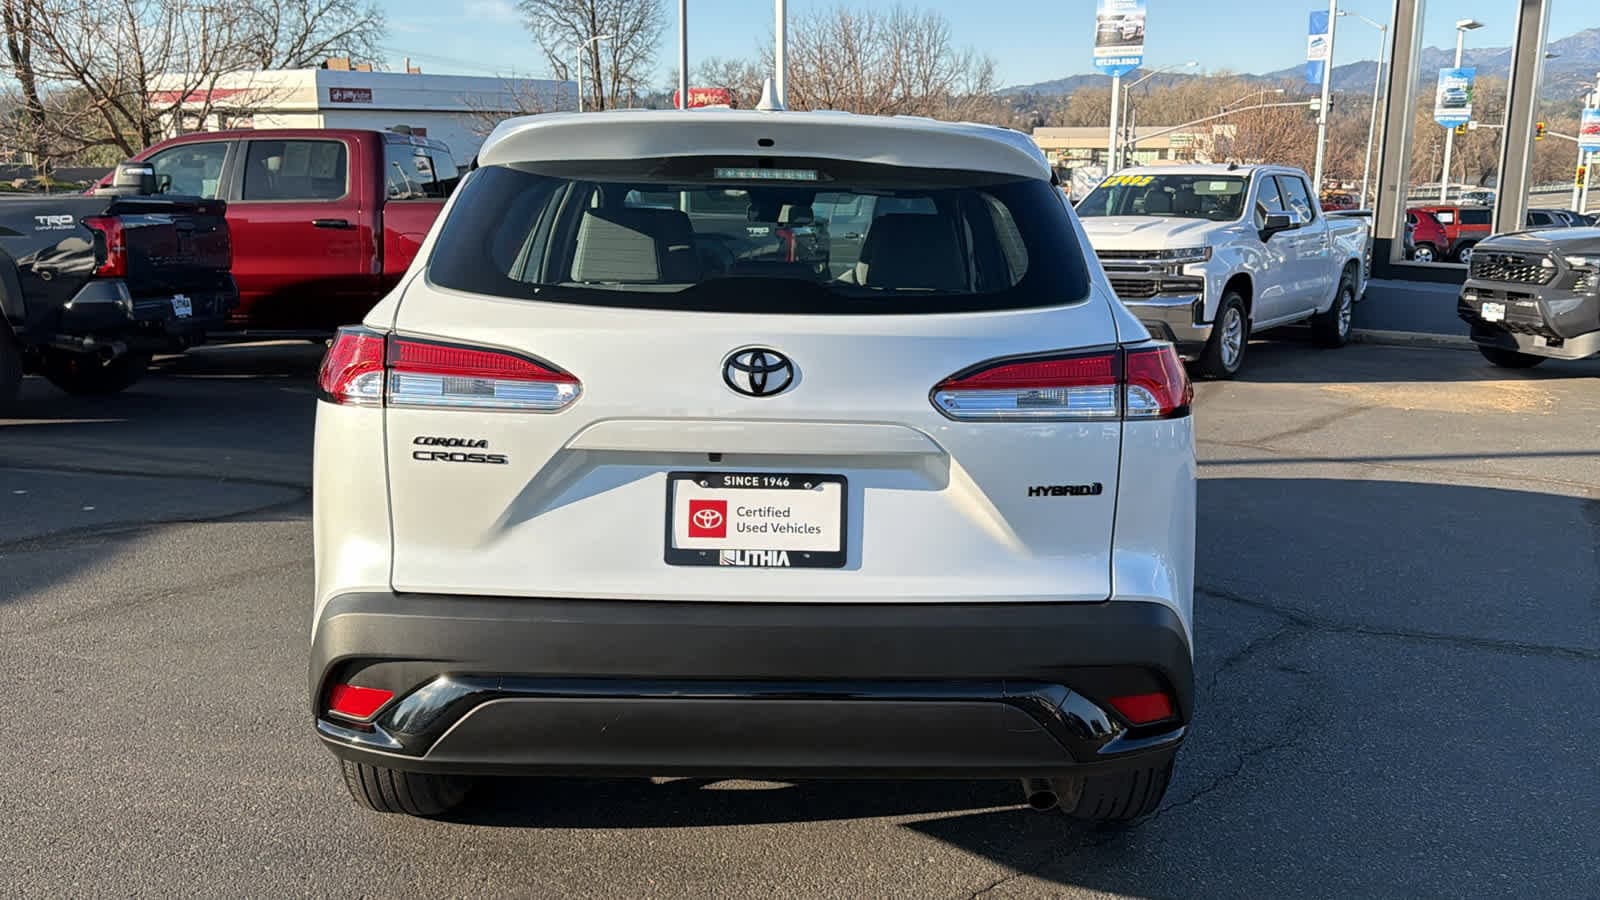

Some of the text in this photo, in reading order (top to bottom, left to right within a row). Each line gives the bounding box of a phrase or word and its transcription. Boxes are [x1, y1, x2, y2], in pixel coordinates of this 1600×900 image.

[34, 214, 73, 225] TRD
[413, 436, 488, 448] COROLLA
[413, 451, 508, 464] CROSS
[723, 475, 790, 487] SINCE 1946
[736, 506, 790, 518] Certified
[736, 522, 821, 535] Used Vehicles
[735, 549, 790, 566] LITHIA
